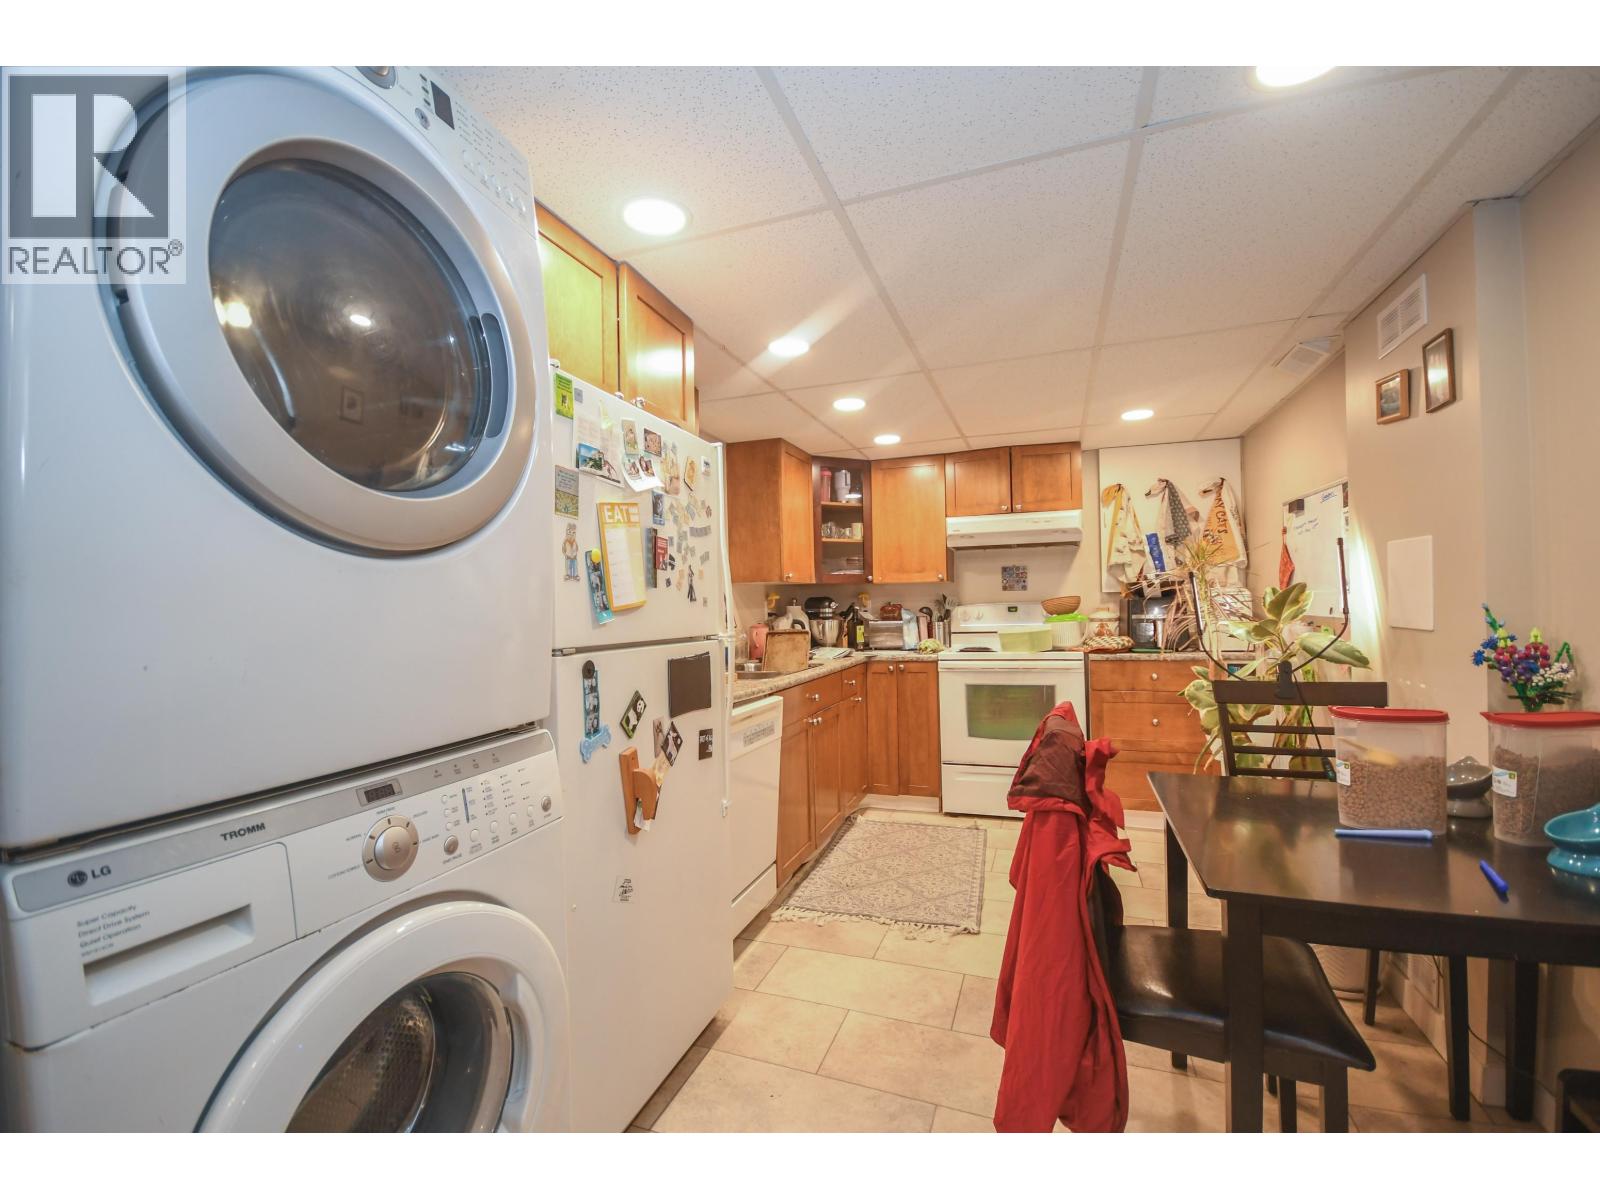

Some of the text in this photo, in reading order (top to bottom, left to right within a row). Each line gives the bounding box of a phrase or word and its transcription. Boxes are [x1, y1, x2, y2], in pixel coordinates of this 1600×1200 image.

[604, 505, 631, 524] EAT
[220, 822, 266, 841] TROMM
[91, 865, 112, 879] LG
[101, 905, 136, 919] Capacity
[103, 923, 141, 940] Operation
